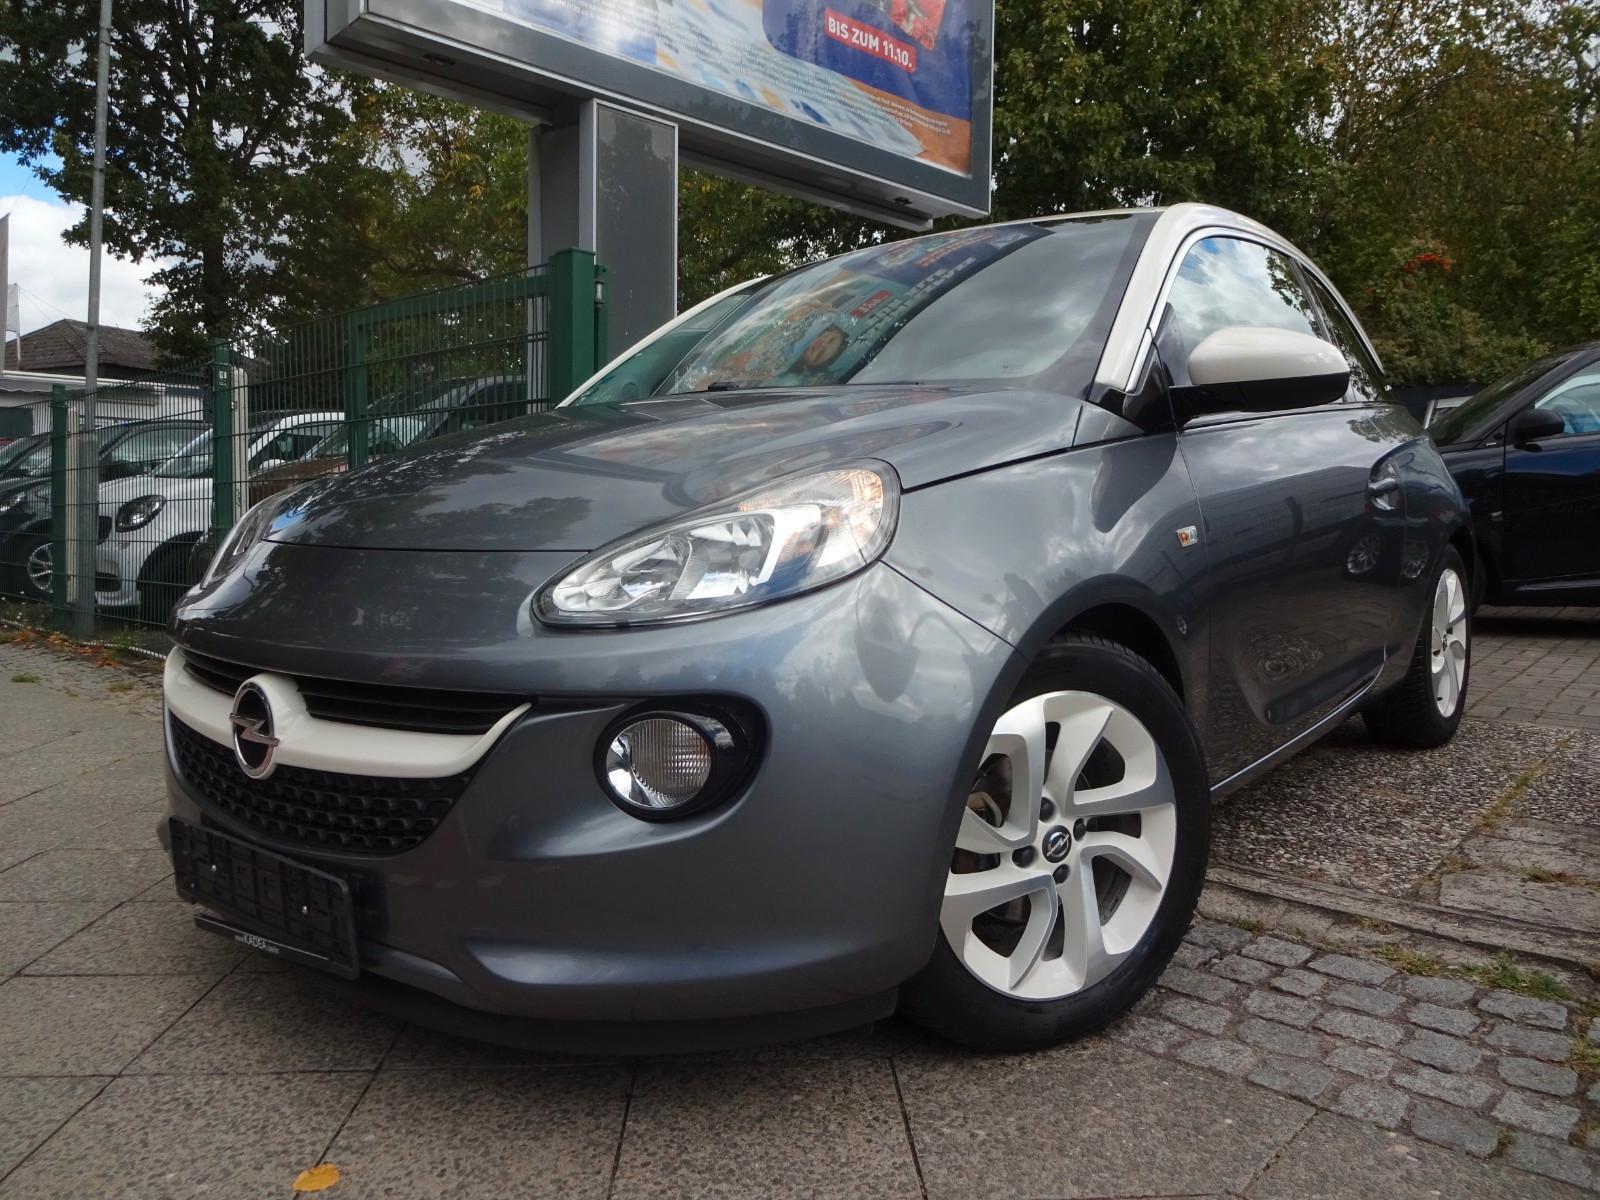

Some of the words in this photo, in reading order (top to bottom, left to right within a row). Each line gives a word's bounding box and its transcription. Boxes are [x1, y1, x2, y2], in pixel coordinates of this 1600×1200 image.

[828, 16, 848, 39] BIS
[851, 28, 879, 52] ZUM
[883, 41, 912, 67] 11.10.
